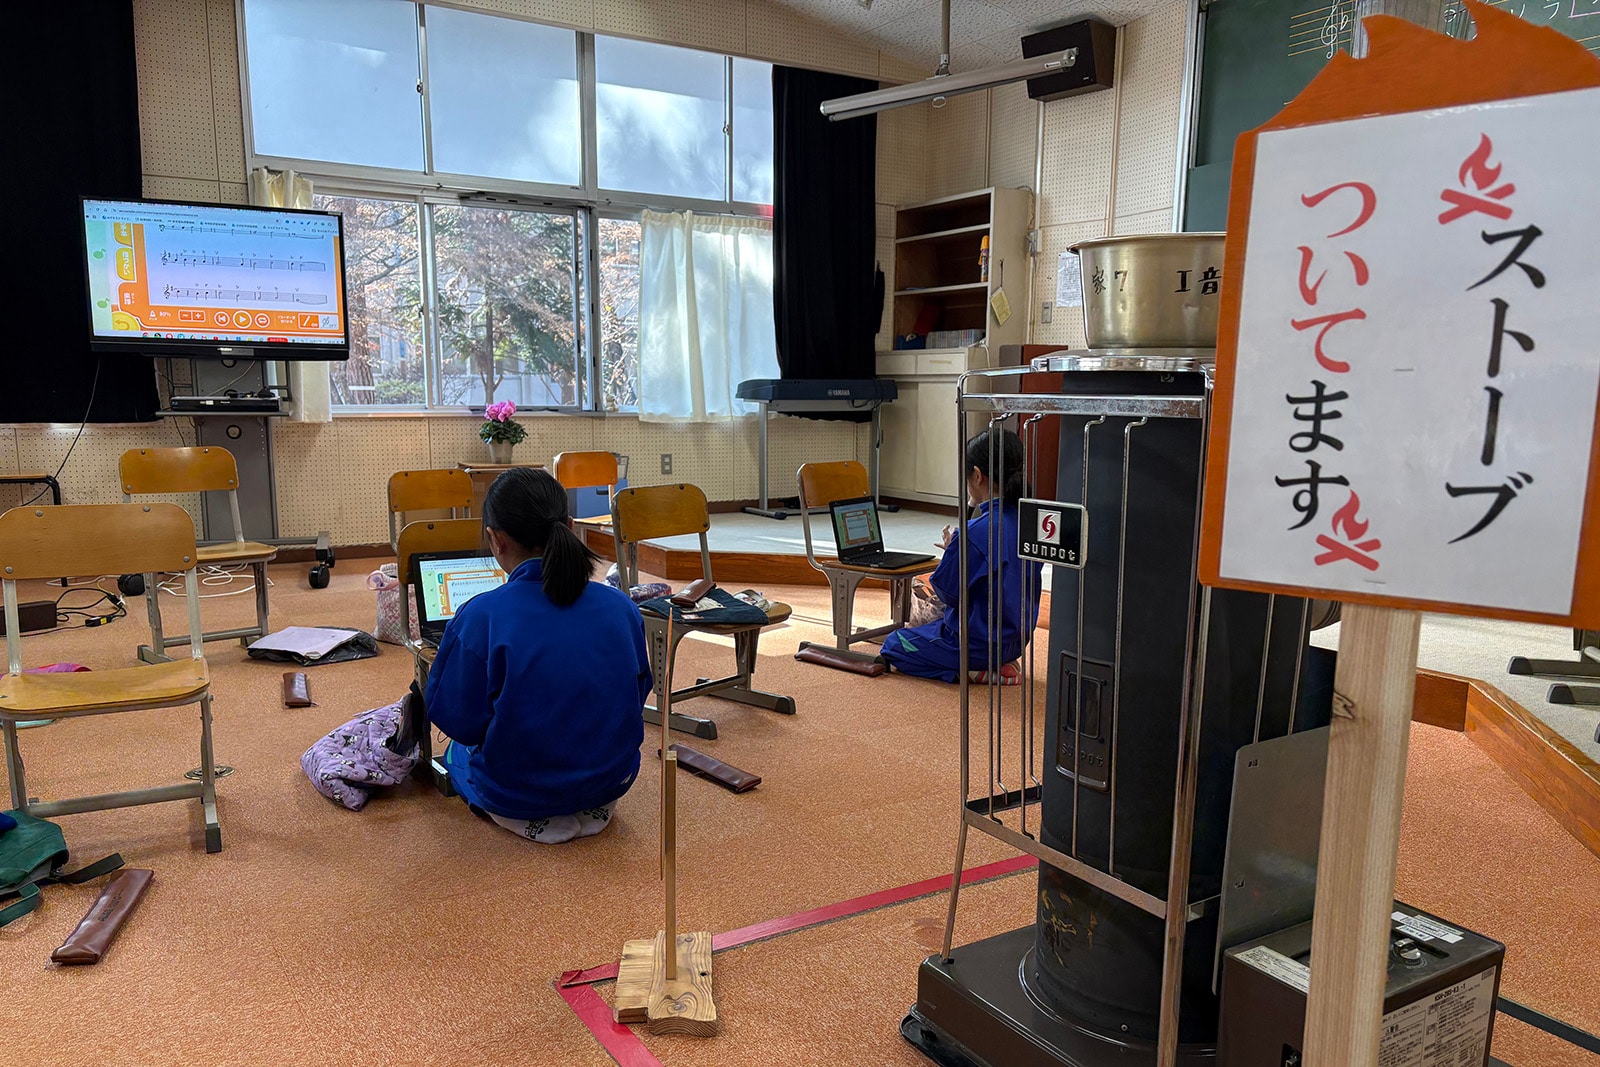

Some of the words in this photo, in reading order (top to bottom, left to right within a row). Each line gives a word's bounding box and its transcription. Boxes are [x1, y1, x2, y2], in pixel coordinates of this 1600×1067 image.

[1274, 181, 1377, 531] ついてます
[1446, 223, 1546, 545] ストーブ
